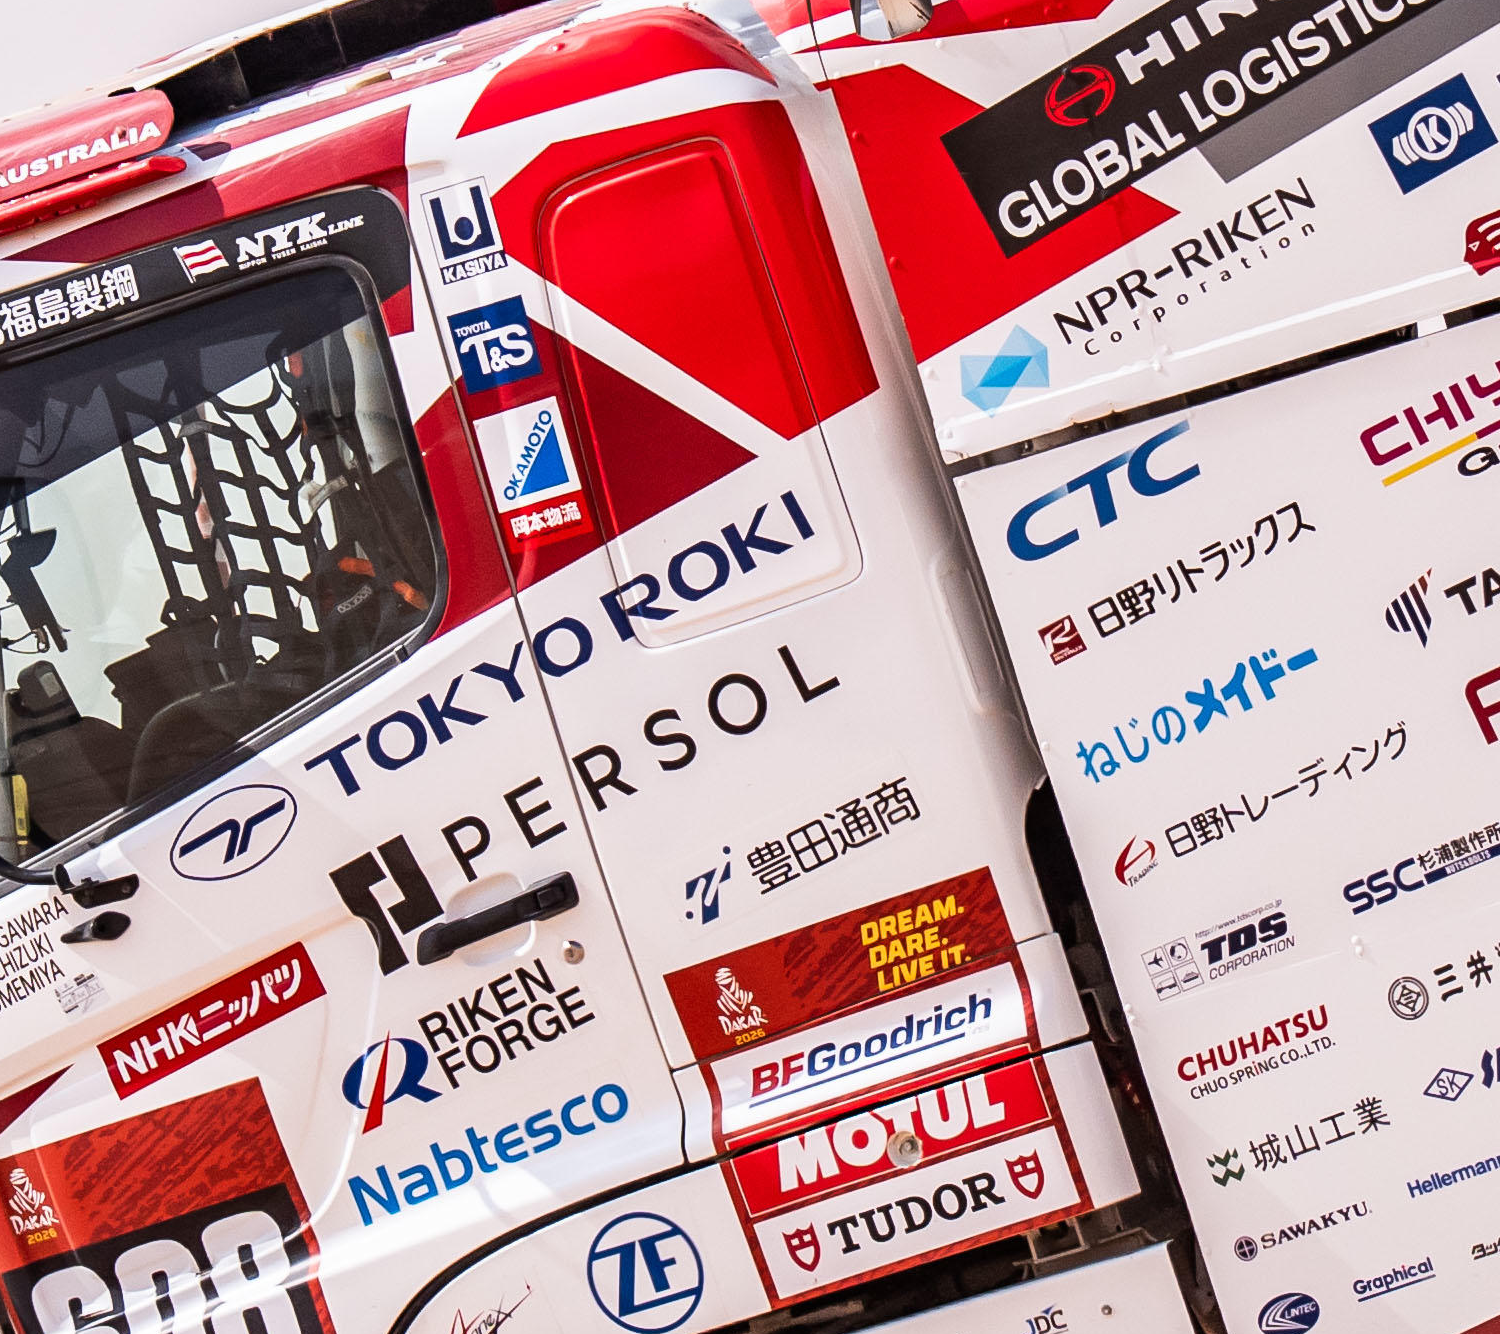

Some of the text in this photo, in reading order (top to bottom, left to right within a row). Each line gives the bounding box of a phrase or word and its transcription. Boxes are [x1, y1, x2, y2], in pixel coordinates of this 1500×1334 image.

[998, 109, 1186, 238] GLOBAL
[235, 212, 364, 264] NYK LINE
[238, 239, 328, 269] NIPPON YUSEN KAISHA
[444, 252, 507, 284] KASUYA
[1052, 177, 1316, 346] NPR-RIKEN
[1084, 222, 1316, 357] Corporation
[454, 320, 491, 338] TOYOTA
[460, 324, 533, 374] T&S
[503, 409, 552, 501] OKAMOTO
[510, 501, 582, 538] 岡本物流
[1006, 420, 1200, 562] CTC
[1088, 501, 1316, 638] 日野リトラックス
[304, 490, 814, 795] TOKYO ROKI
[1076, 647, 1319, 783] ねじのメイドー
[442, 644, 840, 882] PERSOL
[1164, 721, 1409, 859] 日野トレーディング
[746, 776, 921, 895] 豊田通商
[1343, 857, 1425, 915] SSC
[860, 894, 965, 946] DREAM.
[870, 925, 948, 970] DARE.
[1201, 912, 1287, 964] TDS
[877, 943, 971, 993] LIVE IT.
[1209, 936, 1295, 980] CORPORATION
[418, 958, 556, 1053] RIKEN
[435, 986, 595, 1089] FORGE
[718, 1006, 768, 1035] DAKAR
[735, 1027, 766, 1045] 2026
[751, 993, 992, 1097] BFGoodrich
[1177, 1005, 1330, 1083] CHUHATSU
[1438, 1074, 1459, 1098] SK
[348, 1082, 629, 1225] Nabtesco
[780, 1074, 1005, 1194] MOTUL
[1249, 1096, 1391, 1173] 城山工業
[9, 1205, 60, 1236] DAKAR
[26, 1228, 58, 1245] 2026
[827, 1171, 1004, 1254] TUDOR
[1261, 1201, 1368, 1250] SAWAKYU
[594, 1222, 700, 1322] ZF
[1353, 1257, 1434, 1295] Graphical
[1284, 1299, 1316, 1320] LINTEC
